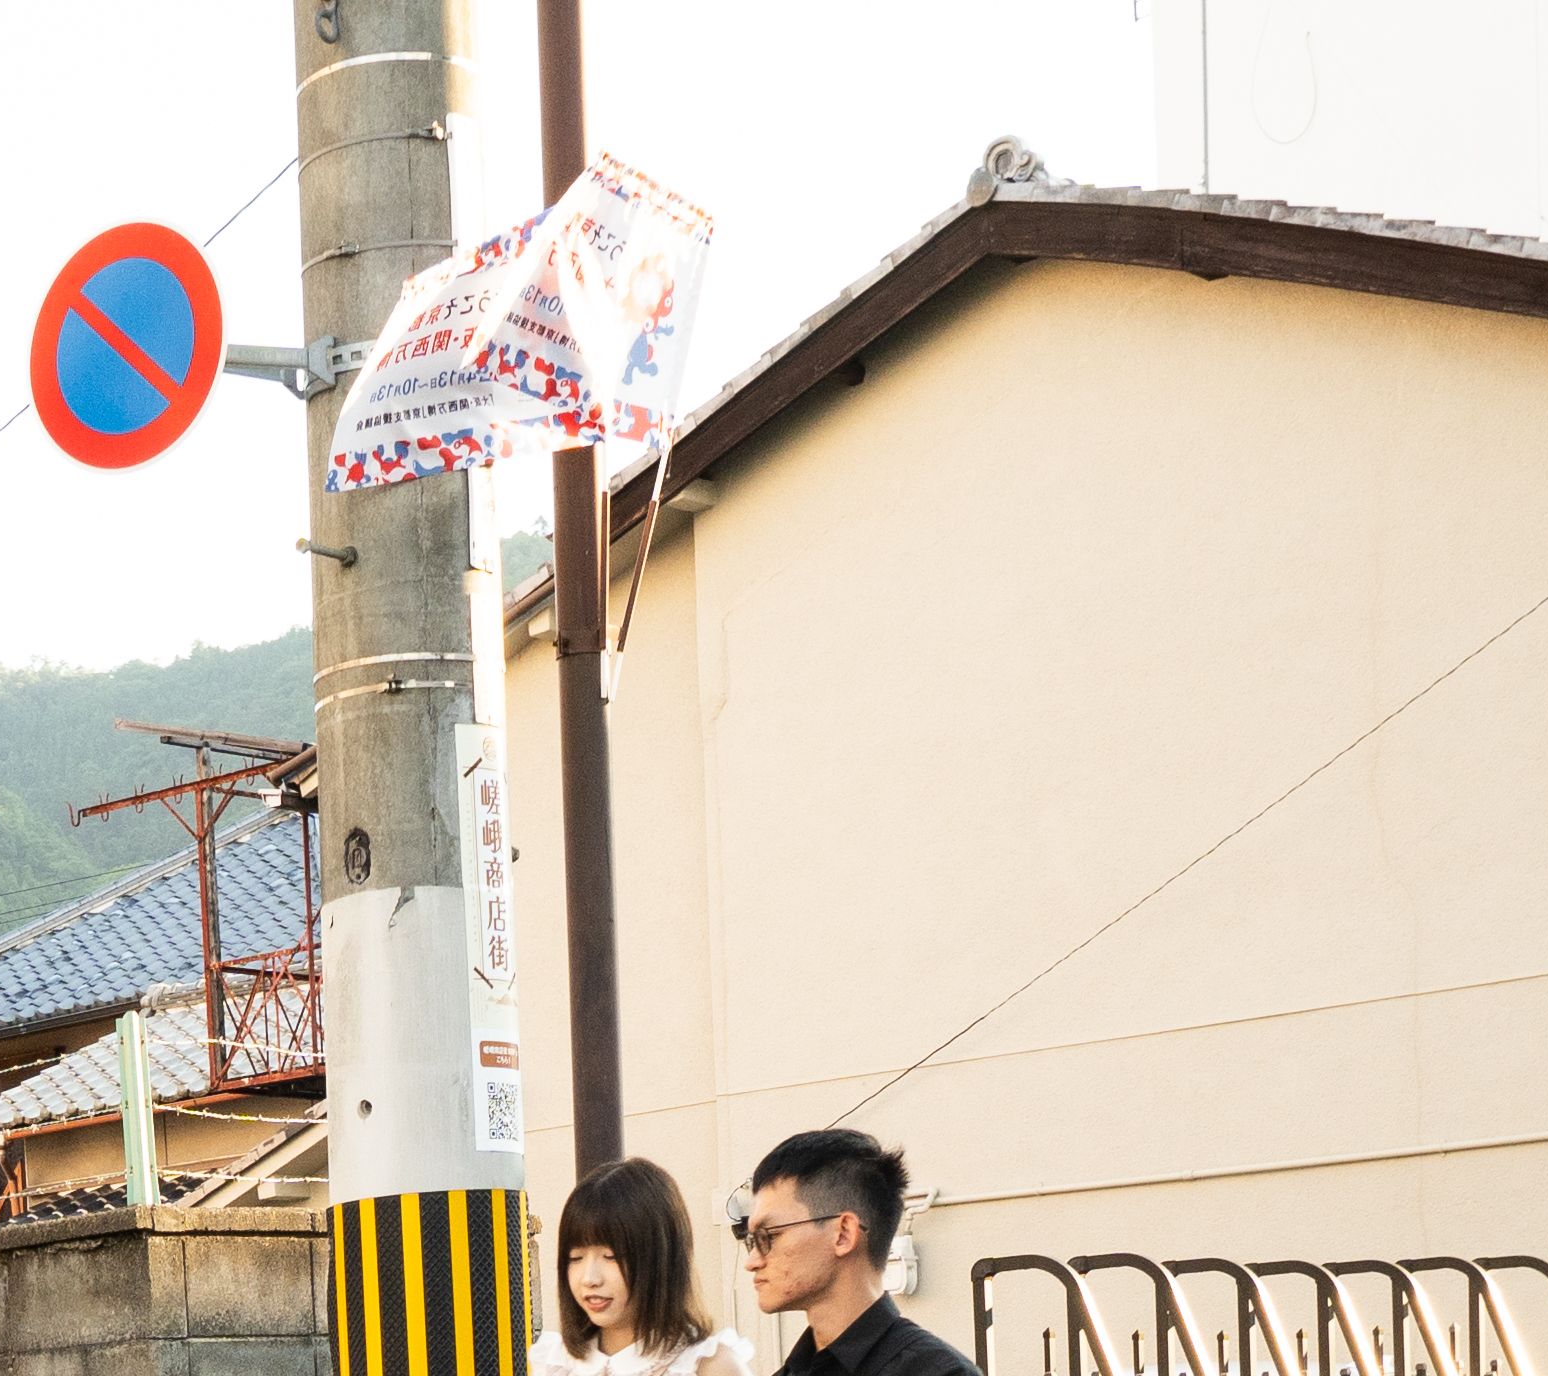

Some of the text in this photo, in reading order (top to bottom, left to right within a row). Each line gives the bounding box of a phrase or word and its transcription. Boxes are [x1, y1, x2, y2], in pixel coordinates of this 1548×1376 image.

[480, 779, 510, 972] 嵯峨商店街
